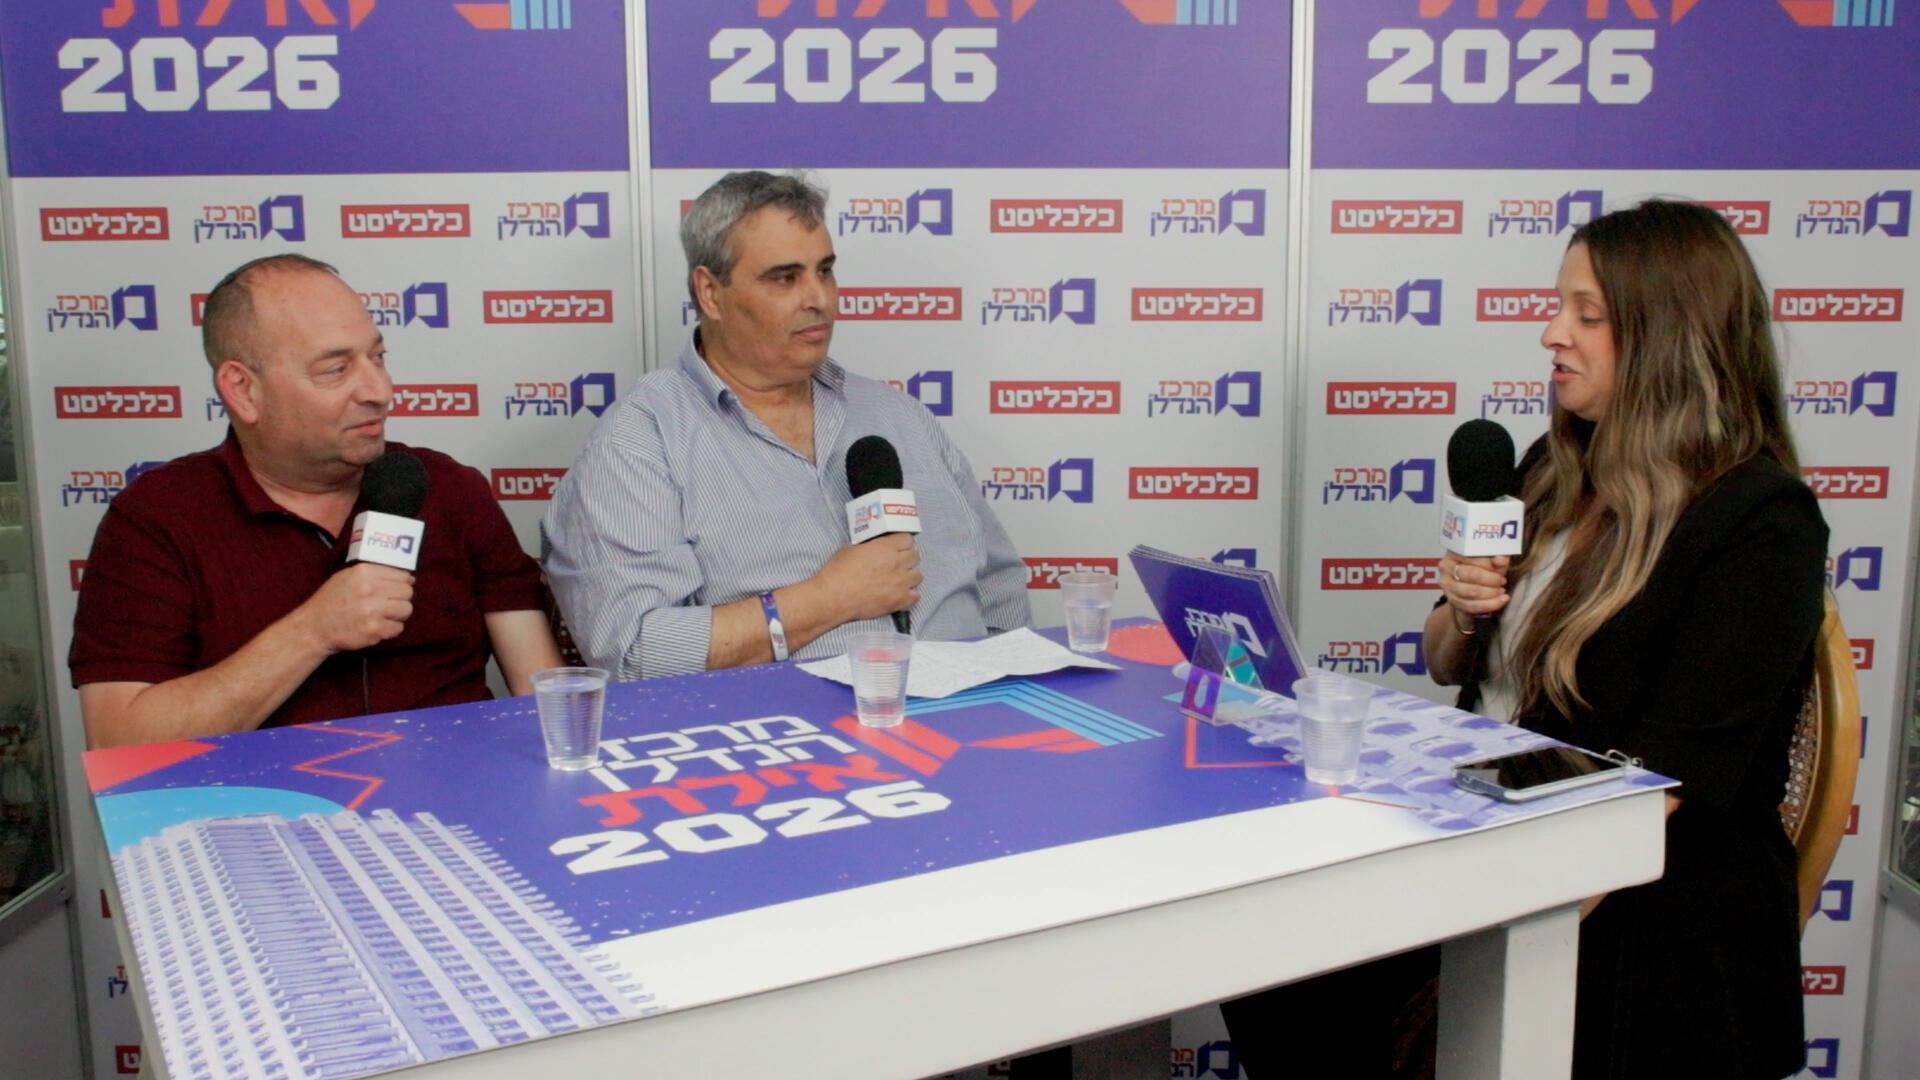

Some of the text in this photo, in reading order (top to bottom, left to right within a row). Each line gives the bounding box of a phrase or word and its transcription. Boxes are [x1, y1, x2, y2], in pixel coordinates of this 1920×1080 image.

[57, 35, 341, 112] 2026
[708, 28, 998, 103] 2026
[1366, 29, 1656, 104] 2026
[205, 205, 256, 221] מרכז
[508, 202, 561, 218] מרכז
[850, 198, 903, 214] מרכז
[999, 205, 1114, 226] כלכליסט
[1162, 198, 1216, 215] מרכז
[1340, 206, 1454, 227] כלכליסט
[1500, 200, 1553, 216] מרכז
[1809, 200, 1862, 216] מרכז
[48, 213, 161, 235] כלכליסט
[349, 210, 462, 232] כלכליסט
[57, 294, 109, 310] מרכז
[839, 293, 954, 314] כלכליסט
[994, 288, 1046, 303] מרכז
[1140, 293, 1255, 314] כלכליסט
[1340, 288, 1392, 304] מרכז
[1484, 294, 1560, 316] כליסט
[1781, 294, 1895, 315] כלכליסט
[491, 296, 604, 317] כלכליסט
[516, 383, 568, 398] מרכז
[998, 387, 1112, 408] כלכליסט
[1160, 381, 1212, 396] מרכז
[1335, 387, 1448, 408] כלכליסט
[1493, 381, 1546, 396] מרכז
[1797, 381, 1848, 396] מרכז
[63, 392, 174, 412] כלכליסט
[388, 389, 471, 411] כלכלי
[72, 470, 123, 486] מרכז
[499, 474, 561, 495] ליסט
[992, 466, 1045, 483] מרכז
[1137, 472, 1250, 493] כלכליסט
[1336, 468, 1386, 484] מרכז
[1806, 471, 1880, 493] כלכלי
[1329, 563, 1440, 584] כלכליסט
[1330, 641, 1381, 656] מרכז
[600, 715, 822, 761] מרכז
[588, 735, 857, 792] הנדלן
[578, 754, 907, 827] אילת
[549, 780, 952, 875] 2026
